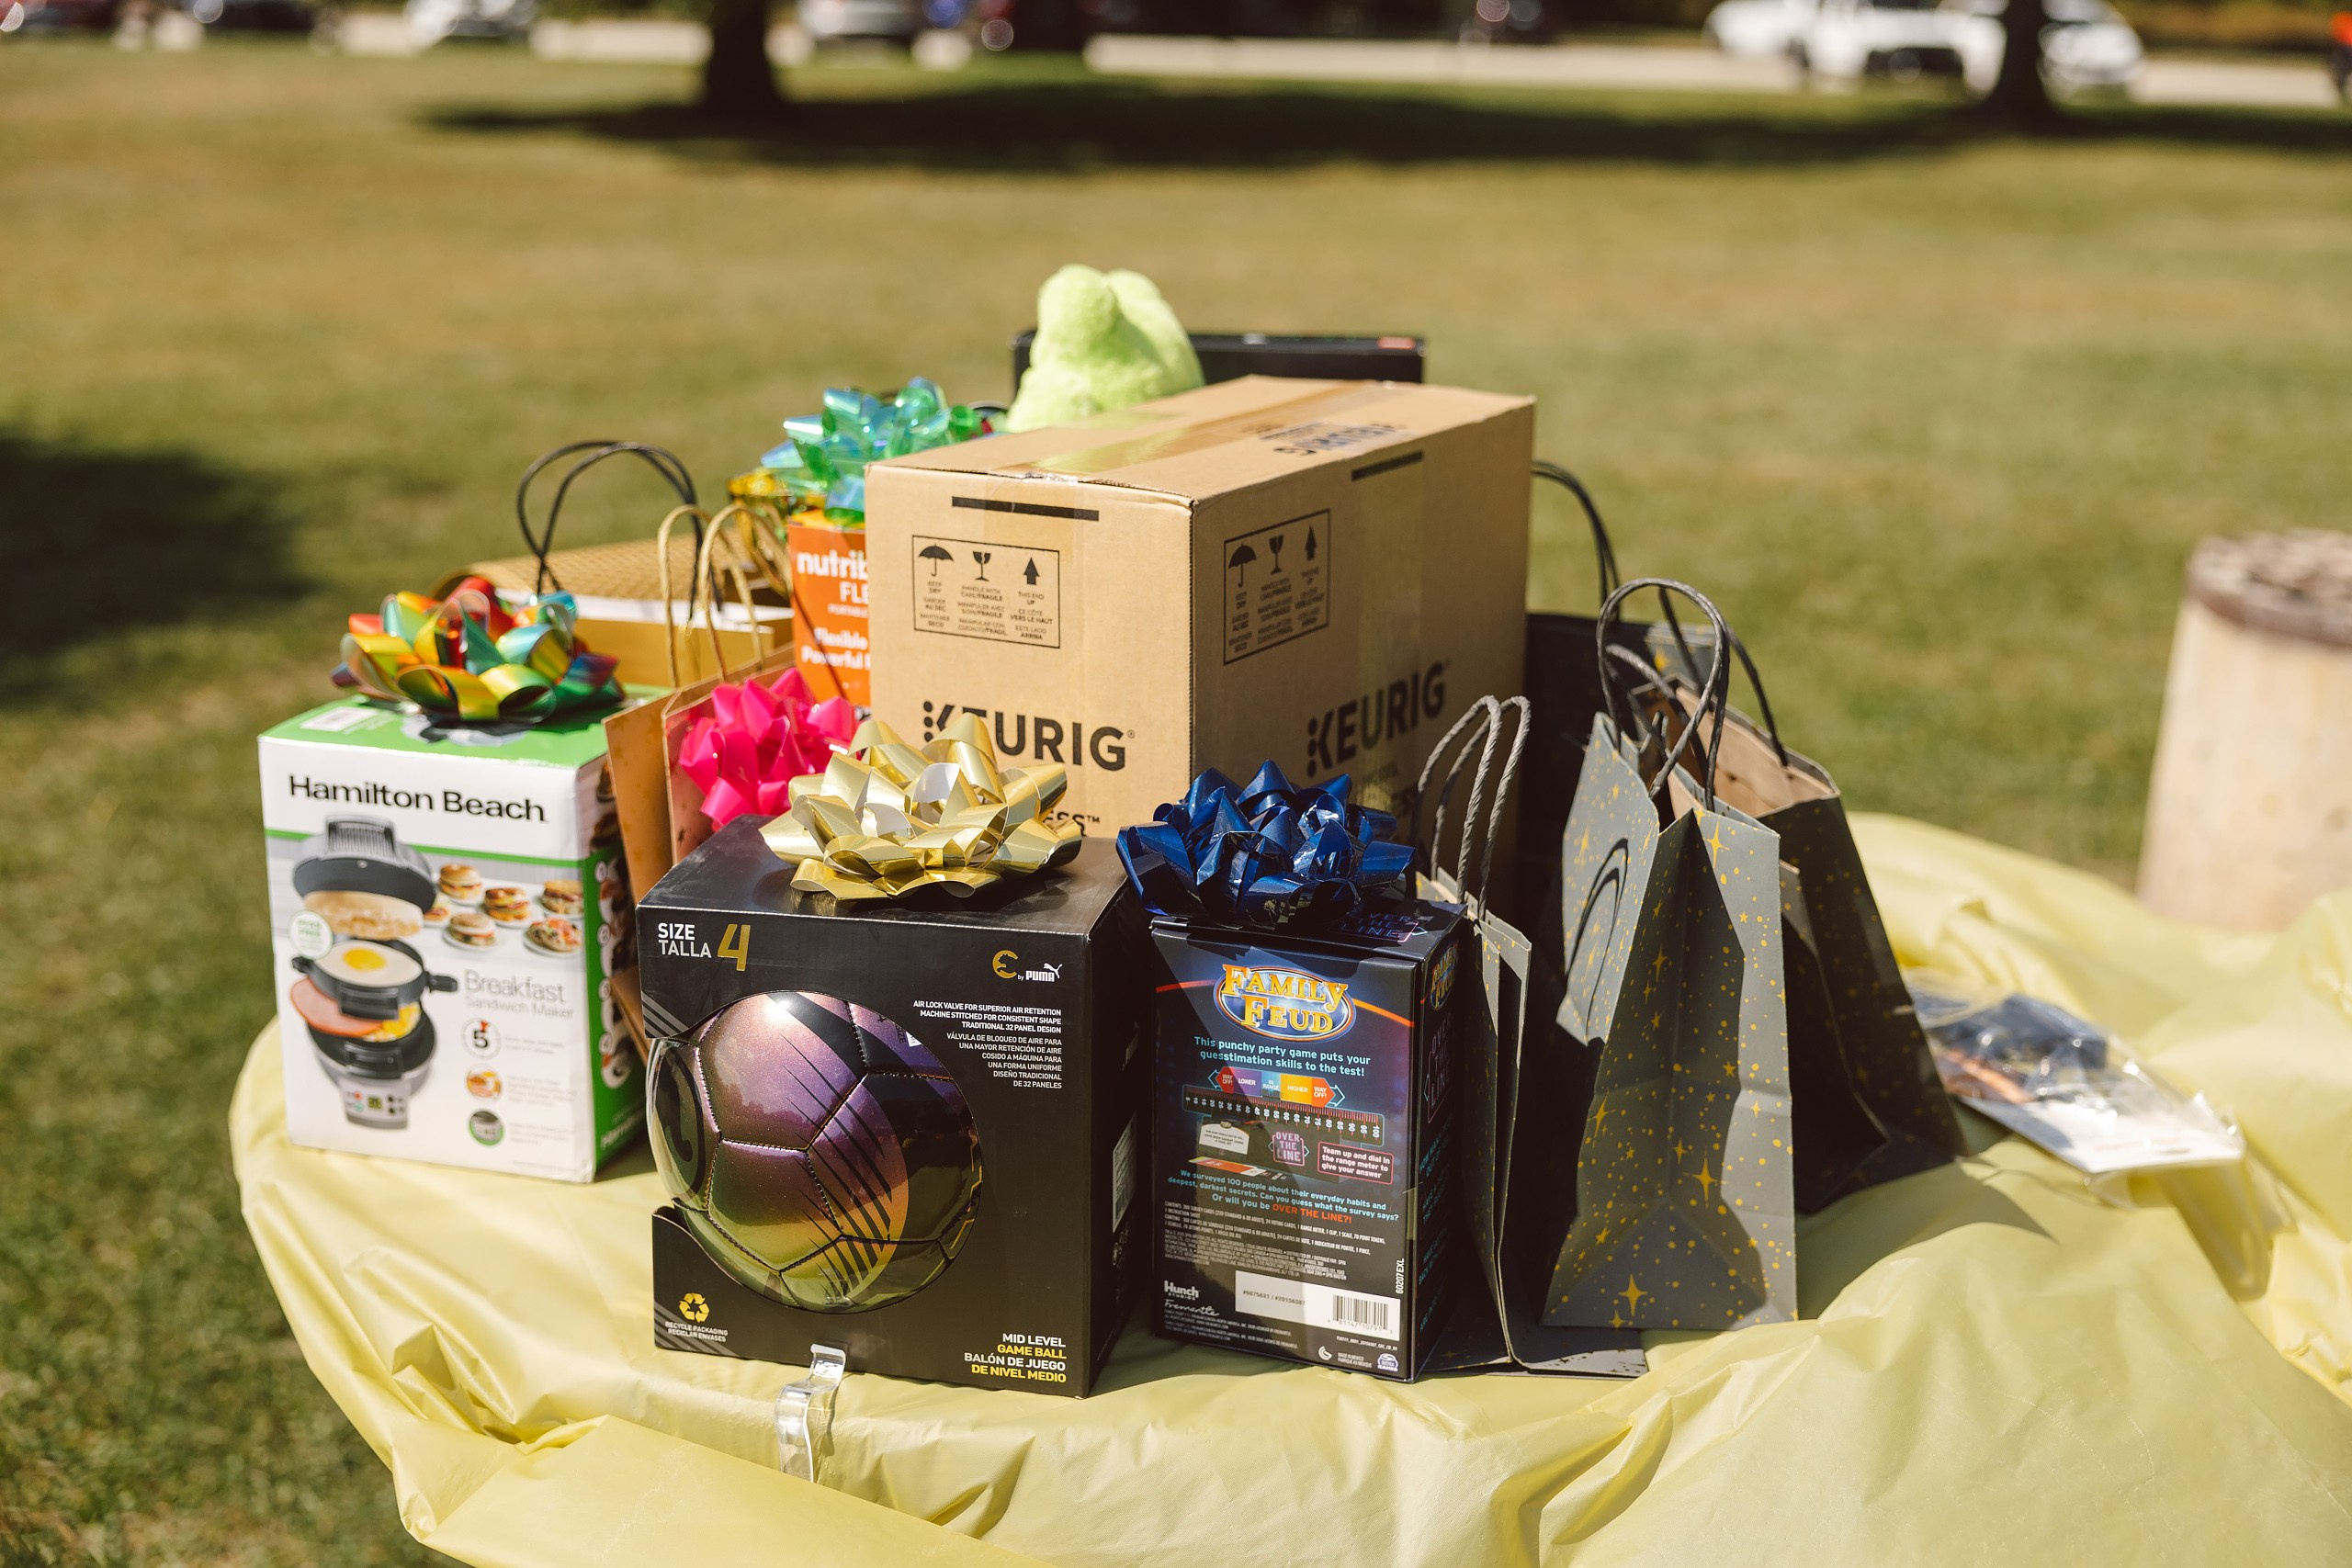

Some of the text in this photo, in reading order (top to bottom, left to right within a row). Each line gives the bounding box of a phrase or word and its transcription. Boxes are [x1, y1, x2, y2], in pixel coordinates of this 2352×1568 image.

[1306, 661, 1445, 778] KEURIG
[922, 700, 1125, 772] KURIG
[288, 774, 546, 822] Hamilton Beach
[658, 922, 695, 941] SIZE
[658, 939, 712, 959] TALLA
[717, 923, 752, 972] 4
[1025, 970, 1055, 982] PUMA
[464, 969, 565, 1003] Breakfast
[1221, 964, 1349, 1012] FAMILY
[920, 1010, 1062, 1025] MACHINE STITCHED FOR CONSISTENT SHAPE
[978, 1004, 1012, 1013] SUPERIOR
[1024, 1007, 1061, 1016] RETENTION
[1240, 994, 1334, 1033] FEUD
[961, 1021, 1005, 1031] TRADITIONAL
[1014, 1024, 1036, 1032] PANEL
[1036, 1025, 1062, 1034] DESIGN
[473, 1029, 489, 1049] 5
[946, 1031, 976, 1041] VÁLVULA
[986, 1034, 1017, 1043] BLOQUEO
[1018, 1036, 1027, 1044] DE
[1044, 1038, 1062, 1046] PARA
[958, 1042, 974, 1050] UNA
[974, 1043, 998, 1051] MAYOR
[998, 1044, 1035, 1053] RETENCIÓN
[1046, 1046, 1062, 1055] AIRE
[1193, 1036, 1371, 1065] This punchy party game puts your
[981, 1052, 1006, 1060] COSIDO
[1012, 1053, 1044, 1062] MÁQUINA
[1044, 1055, 1062, 1064] PARA
[1200, 1051, 1365, 1077] guesstimation skills to the test!
[993, 1070, 1062, 1080] DISEÑO TRADICIONAL
[1002, 1062, 1026, 1070] FORMA
[1027, 1064, 1062, 1072] UNIFORME
[1032, 1081, 1062, 1089] PANELES
[1238, 1077, 1256, 1086] LOWER
[1287, 1085, 1308, 1093] HIGHER
[1275, 1131, 1300, 1142] OVER
[1279, 1140, 1297, 1150] THE
[1277, 1148, 1302, 1162] LINE
[1322, 1145, 1341, 1156] Team
[1342, 1149, 1352, 1158] up
[1353, 1151, 1367, 1160] and
[1368, 1152, 1382, 1162] dial
[1321, 1154, 1388, 1172] the range meter to
[1321, 1162, 1382, 1179] give your answer
[1193, 1172, 1226, 1183] surveyed
[1227, 1178, 1241, 1186] 100
[1242, 1181, 1266, 1190] people
[1268, 1185, 1289, 1194] about
[1291, 1189, 1309, 1198] their
[1310, 1192, 1345, 1204] everyday
[1346, 1197, 1371, 1208] habits
[1372, 1201, 1386, 1211] and
[1200, 1181, 1227, 1192] darkest
[1228, 1188, 1258, 1198] secrets.
[1260, 1191, 1274, 1201] Can
[1275, 1195, 1290, 1203] you
[1291, 1198, 1313, 1207] guess
[1314, 1201, 1334, 1211] what
[1334, 1204, 1348, 1213] the
[1349, 1208, 1375, 1218] survey
[1376, 1213, 1399, 1222] says?
[1212, 1193, 1352, 1224] Or will you be OVER THE LINE?!
[1163, 1280, 1199, 1298] Hunch
[1164, 1298, 1220, 1316] Fremantle
[664, 1321, 729, 1336] RECYCLE PACKAGING
[698, 1332, 727, 1342] ENVASES
[1002, 1333, 1067, 1348] MID LEVEL
[997, 1344, 1067, 1359] GAME BALL
[964, 1352, 1066, 1371] BALÓN DE JUEGO
[971, 1364, 1067, 1383] DE NIVEL MEDIO
